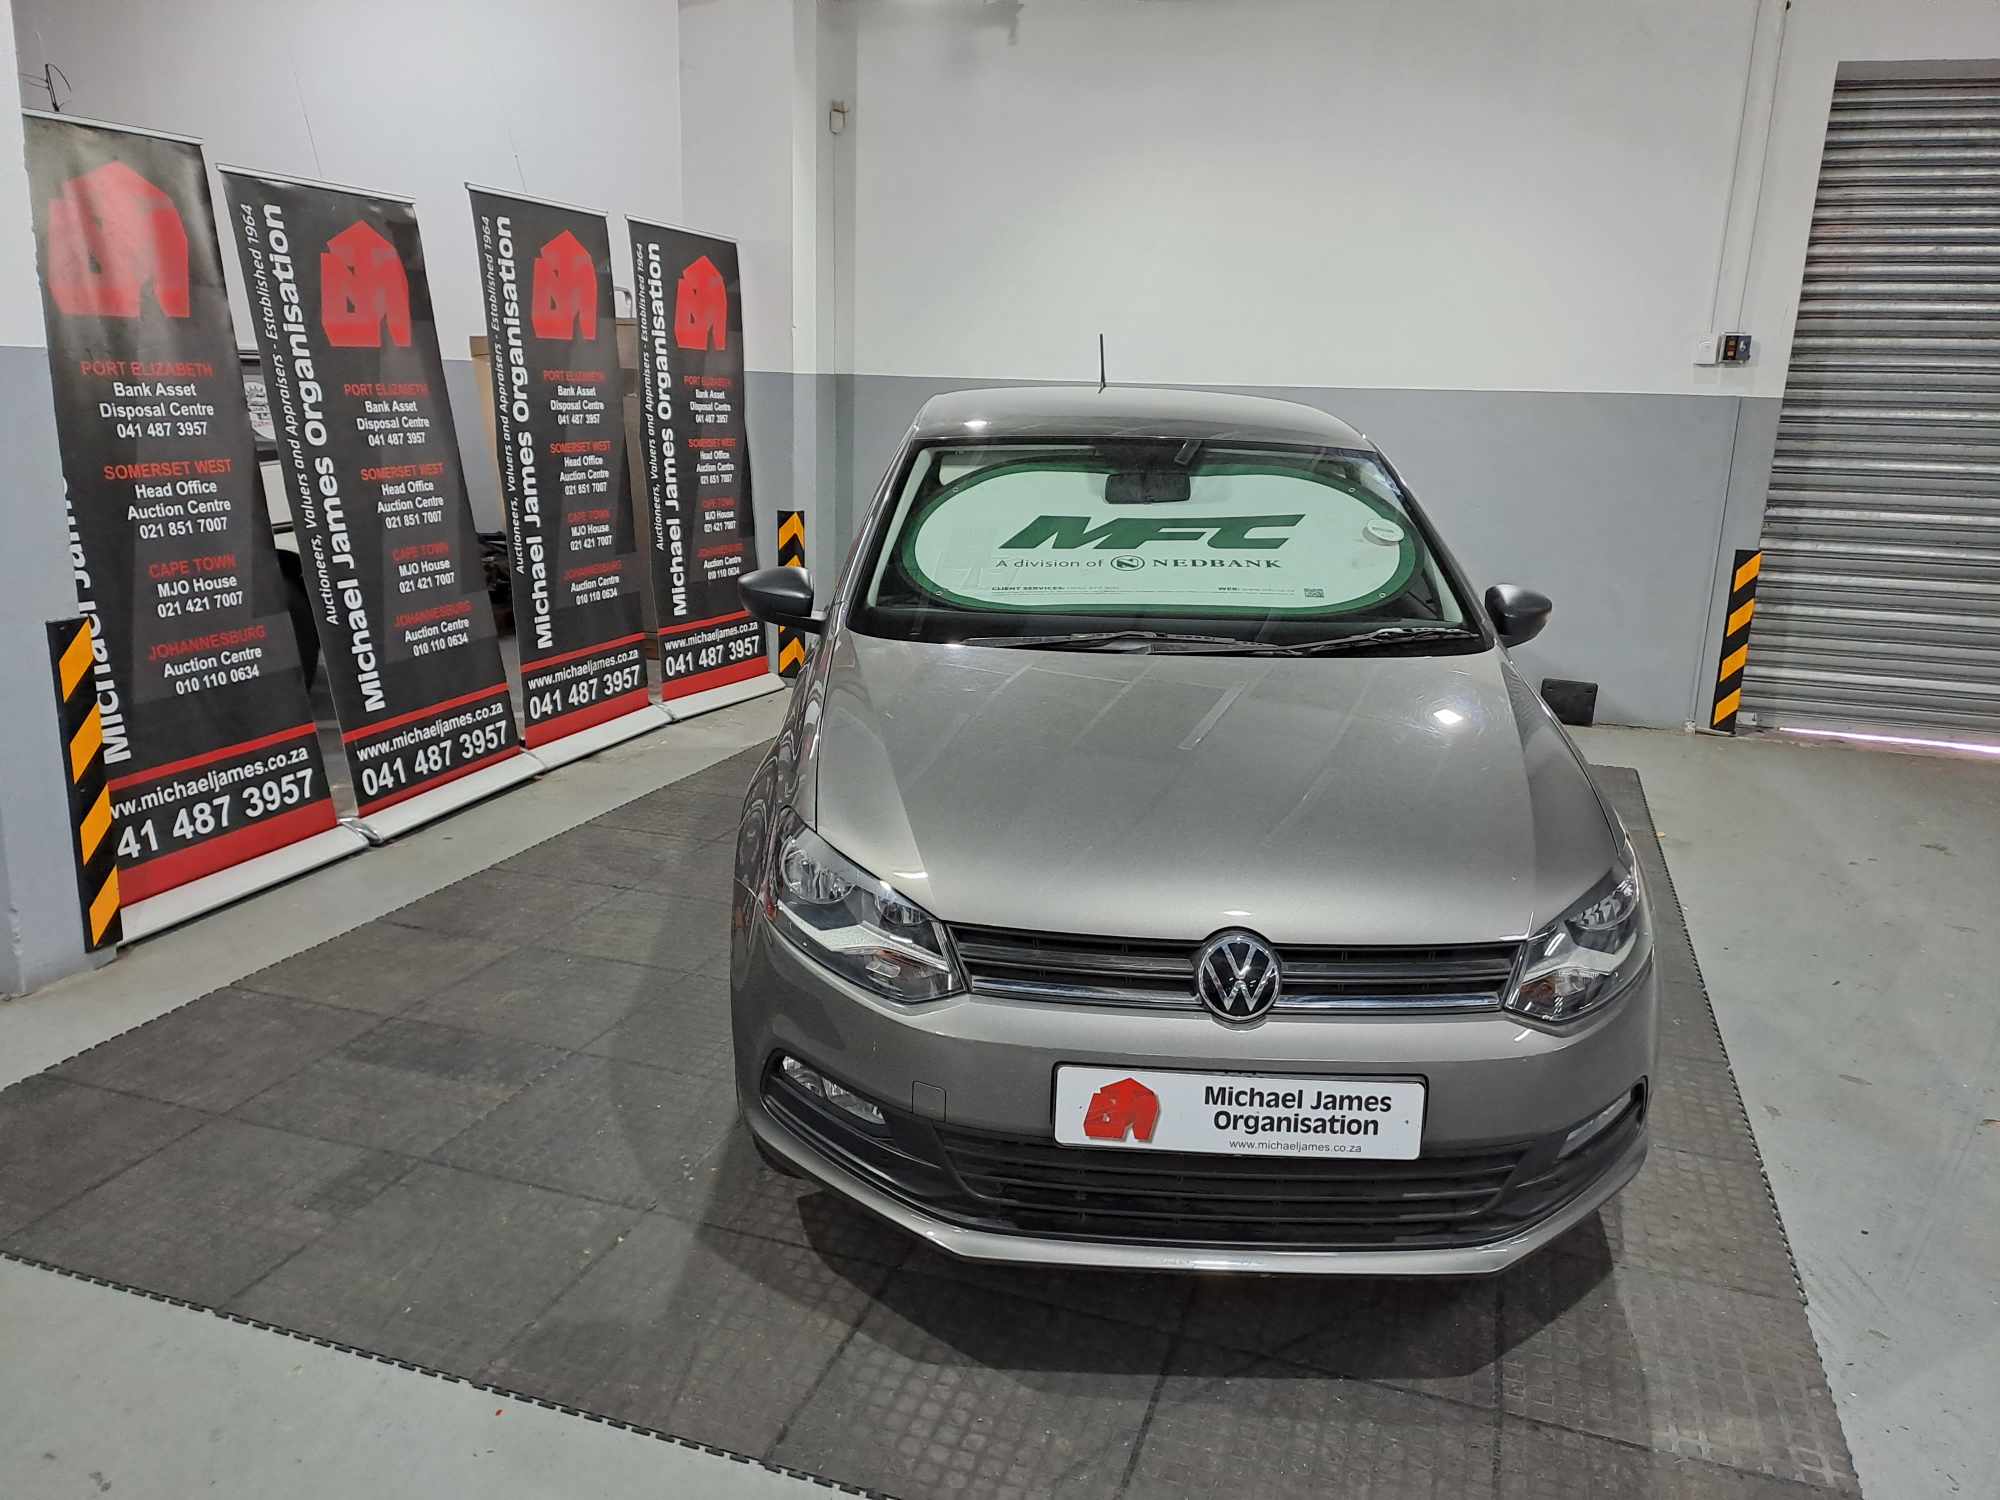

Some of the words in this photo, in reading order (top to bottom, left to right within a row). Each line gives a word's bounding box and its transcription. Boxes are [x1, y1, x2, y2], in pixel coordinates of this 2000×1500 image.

[240, 203, 259, 246] 1964
[480, 216, 492, 249] 1964
[253, 246, 278, 340] Established
[485, 252, 500, 332] Established
[263, 203, 327, 447] organisation
[496, 216, 530, 422] organisation
[113, 382, 152, 397] Bank
[156, 382, 197, 396] Asset
[495, 342, 509, 413] Appraisers
[271, 353, 300, 437] Appraisers
[365, 401, 390, 412] Bank
[392, 400, 418, 412] Asset
[99, 403, 166, 420] Disposal
[170, 402, 214, 416] Centre
[356, 417, 400, 432] Disposal
[402, 416, 430, 428] Centre
[558, 414, 570, 425] 041
[572, 414, 584, 424] 487
[117, 424, 142, 438] 041
[148, 423, 171, 436] 487
[178, 422, 208, 436] 3957
[368, 434, 385, 446] 041
[388, 433, 404, 445] 487
[406, 432, 426, 444] 3957
[500, 415, 511, 442] and
[104, 462, 191, 480] SOMERSET
[195, 459, 232, 474] WEST
[287, 440, 304, 470] and
[503, 445, 516, 492] Valuers
[662, 428, 680, 512] James
[135, 482, 171, 500] Head
[176, 480, 217, 496] Office
[382, 482, 406, 496] Head
[408, 480, 434, 493] Office
[518, 431, 541, 529] James
[560, 471, 586, 482] Auction
[588, 470, 610, 480] Centre
[127, 502, 184, 521] Auction
[187, 498, 232, 516] Centre
[297, 471, 316, 530] Valuers
[315, 457, 355, 569] James
[378, 500, 414, 514] Auction
[415, 496, 444, 508] Centre
[140, 524, 166, 539] 021
[168, 522, 193, 536] 851
[198, 517, 228, 533] 7007
[386, 516, 402, 529] 021
[404, 514, 420, 526] 851
[422, 511, 442, 524] 7007
[999, 514, 1305, 550] MFC
[510, 497, 525, 575] Auctioneers,
[149, 560, 190, 579] CAPE
[193, 554, 237, 572] TOWN
[399, 563, 419, 577] MJO
[421, 560, 450, 573] House
[666, 518, 687, 616] Michael
[996, 558, 1008, 568] A
[1014, 558, 1084, 568] division
[1086, 558, 1103, 568] of
[1152, 558, 1282, 568] NEDBANK
[158, 580, 189, 598] MJO
[193, 576, 238, 593] House
[310, 534, 339, 626] Auctioneers,
[399, 581, 415, 594] 021
[417, 576, 432, 590] 421
[435, 572, 455, 587] 7007
[526, 536, 553, 649] Michael
[158, 602, 182, 618] 021
[186, 598, 210, 613] 421
[214, 591, 244, 609] 7007
[149, 625, 266, 661] JOHANNESBURG
[337, 578, 386, 712] Michael
[405, 625, 439, 642] Auction
[441, 618, 470, 633] Centre
[413, 642, 429, 656] 010
[430, 638, 446, 652] 110
[447, 632, 469, 648] 0634
[164, 656, 218, 678] Auction
[221, 647, 262, 665] Centre
[528, 648, 638, 691] www.michaeljames.co.za
[665, 651, 694, 677] 041
[698, 644, 724, 668] 487
[728, 635, 760, 660] 3957
[176, 678, 200, 695] 010
[203, 672, 226, 688] 110
[230, 664, 260, 683] 0634
[529, 689, 562, 720] 041
[568, 678, 598, 706] 487
[603, 665, 640, 696] 3957
[356, 702, 504, 761] www.michaeljames.co.za
[362, 756, 407, 796] 041
[414, 739, 452, 778] 487
[459, 720, 508, 760] 3957
[116, 819, 160, 860] 41
[172, 796, 232, 840] 487
[242, 768, 314, 818] 3957
[1204, 1086, 1304, 1110] Michael
[1310, 1090, 1393, 1113] James
[1213, 1110, 1380, 1136] Organisation
[1229, 1139, 1362, 1154] www.michaeljames.co.za
